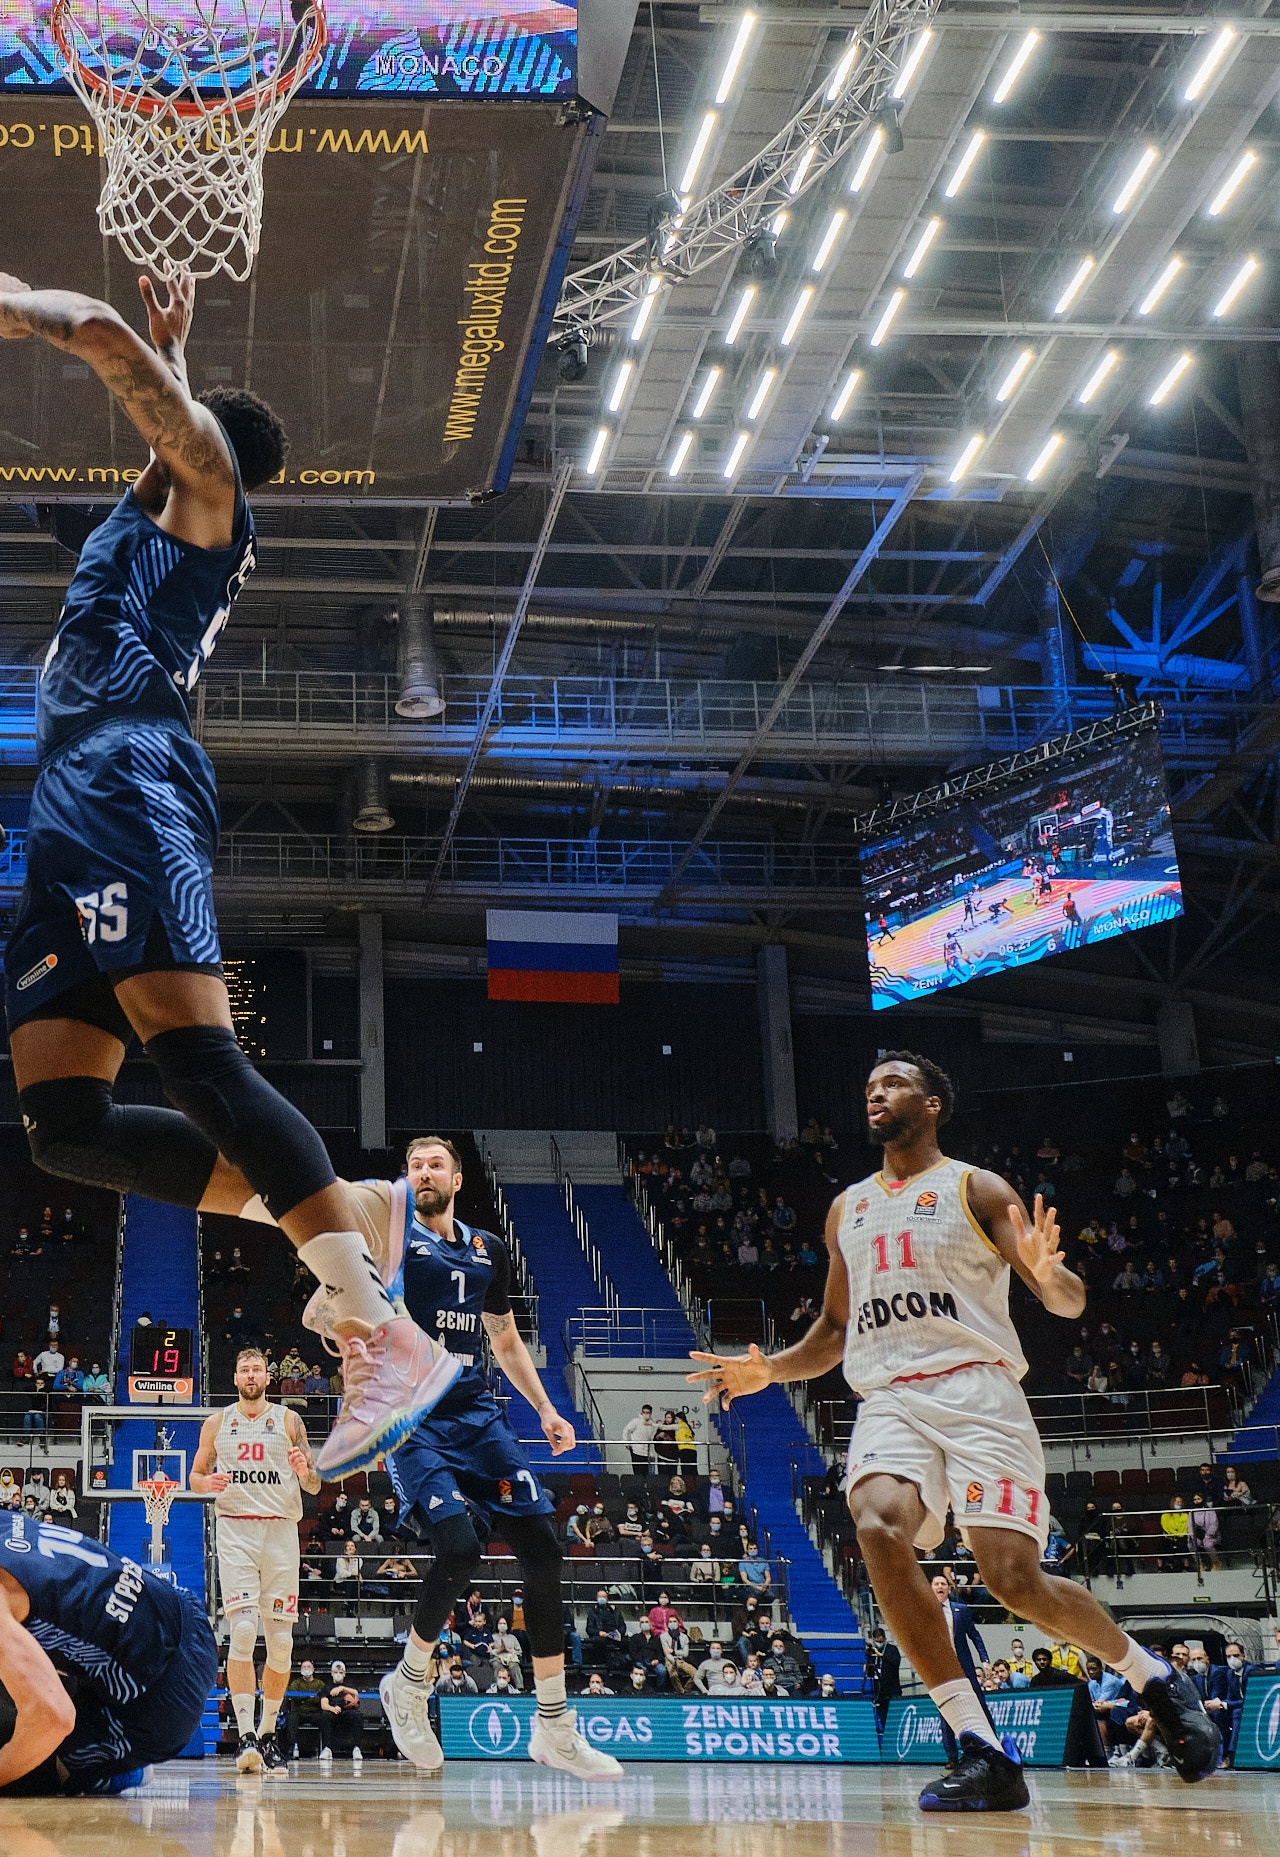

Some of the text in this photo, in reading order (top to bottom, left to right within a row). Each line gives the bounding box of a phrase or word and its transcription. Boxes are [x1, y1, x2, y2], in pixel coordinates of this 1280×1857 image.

[375, 54, 505, 77] MONACO
[443, 198, 527, 442] www.megaluxltd.com
[1093, 909, 1150, 936] MONACO
[999, 936, 1033, 956] 06:27
[1046, 937, 1057, 953] 6
[911, 972, 945, 993] ZENIT
[969, 964, 978, 977] 2
[871, 1229, 918, 1274] 11
[450, 1270, 466, 1304] 7
[436, 1309, 477, 1333] ZENIT
[165, 1331, 176, 1347] 2
[153, 1349, 180, 1373] 19
[137, 1381, 173, 1391] Winline
[682, 1405, 690, 1415] D
[237, 1443, 265, 1462] 20
[517, 1469, 539, 1502] 7
[994, 1476, 1042, 1527] 11
[105, 1592, 134, 1624] ST
[286, 1595, 299, 1613] 2
[682, 1705, 839, 1730] ZENIT TITLE
[1013, 1699, 1044, 1726] TITLE
[686, 1732, 843, 1757] SPONSOR
